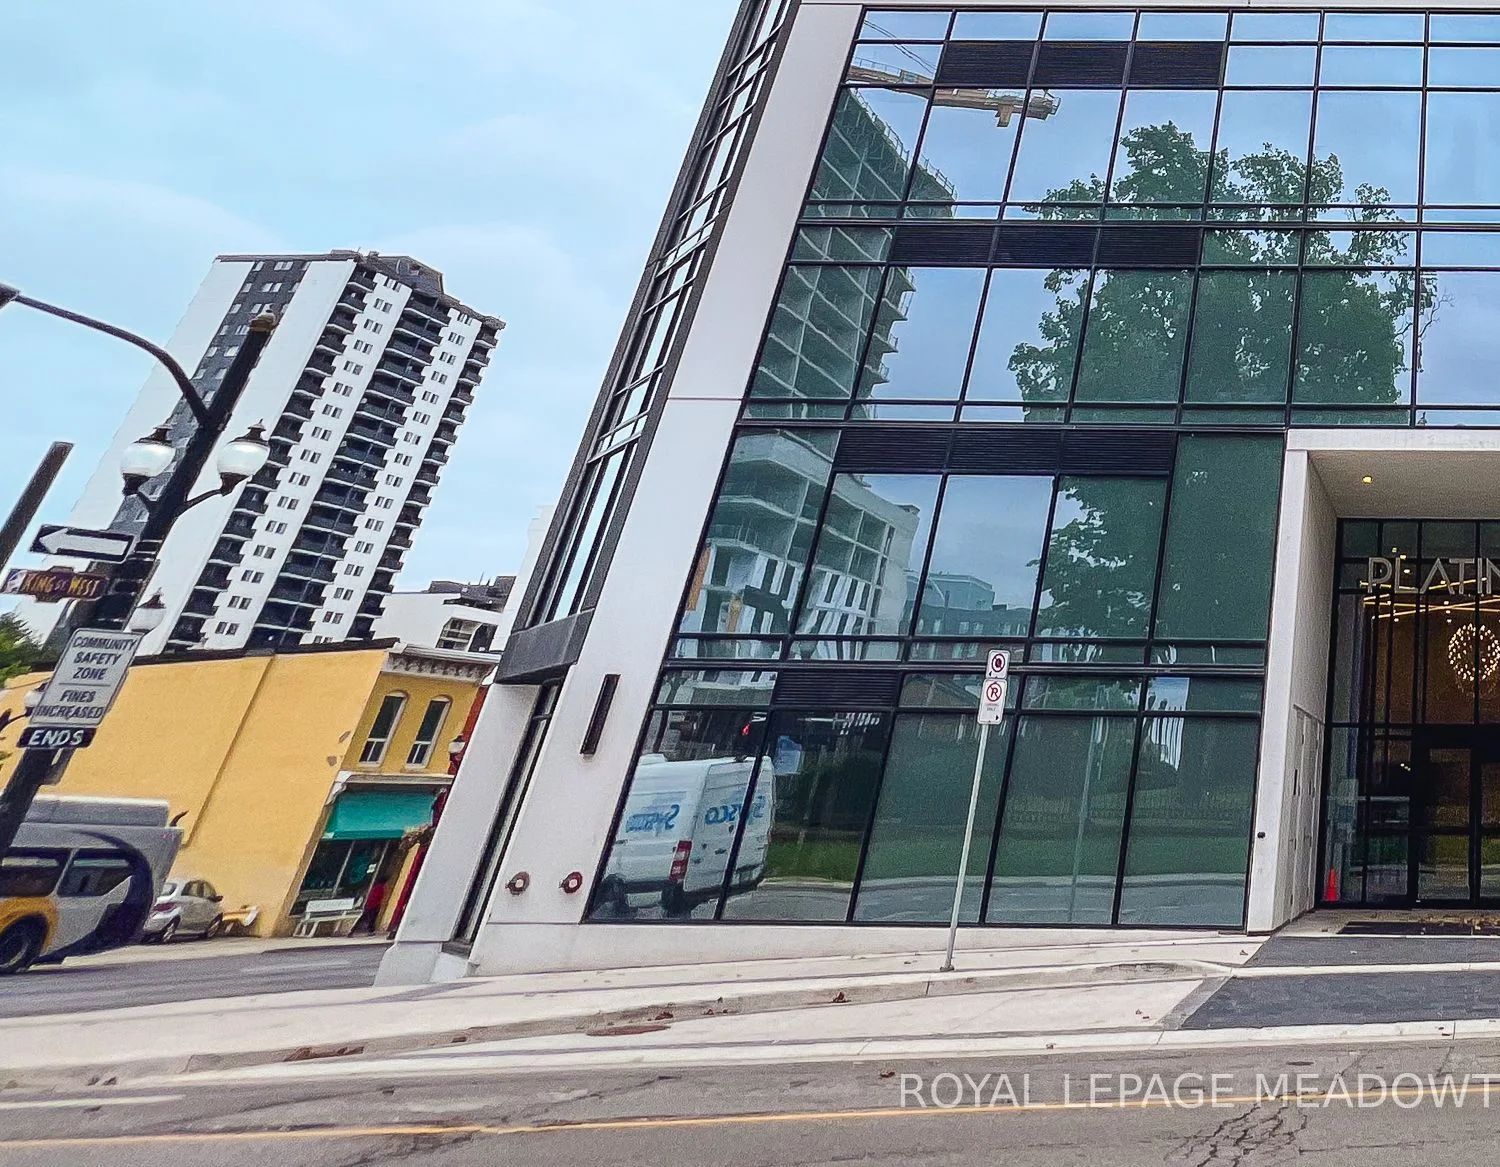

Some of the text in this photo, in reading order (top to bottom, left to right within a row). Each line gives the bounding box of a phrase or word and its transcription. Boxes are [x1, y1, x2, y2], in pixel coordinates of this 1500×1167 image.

[20, 572, 56, 593] KING
[68, 576, 100, 597] WEST
[72, 636, 136, 652] COMMUNITY
[73, 652, 122, 666] SAFETY
[72, 667, 108, 680] ZONE
[59, 689, 97, 703] FINES
[35, 704, 106, 720] INCREASED
[27, 729, 86, 746] ENDS
